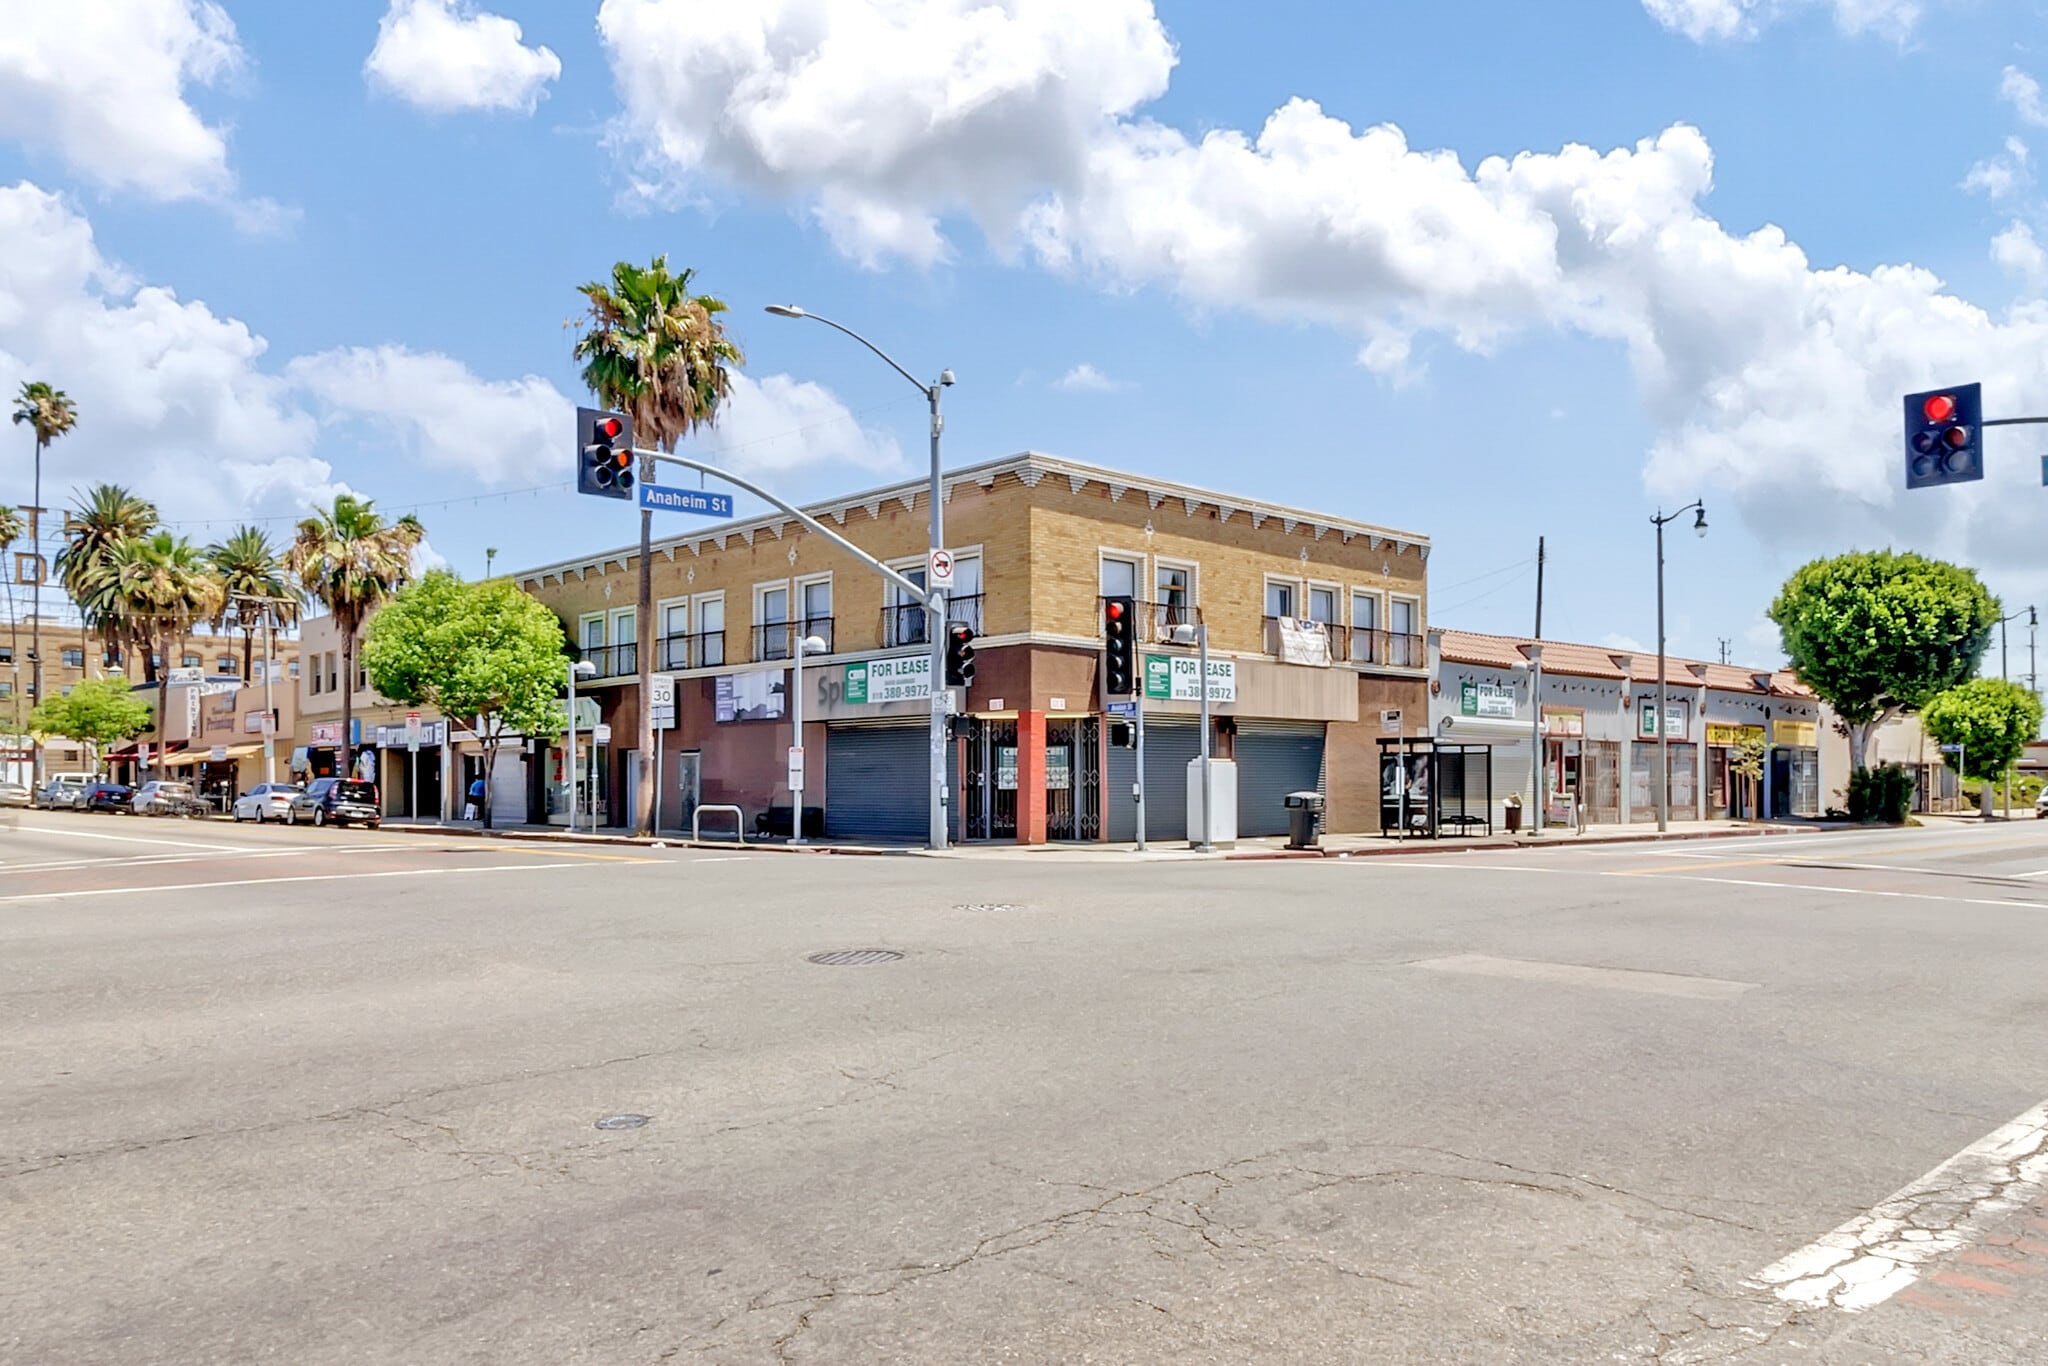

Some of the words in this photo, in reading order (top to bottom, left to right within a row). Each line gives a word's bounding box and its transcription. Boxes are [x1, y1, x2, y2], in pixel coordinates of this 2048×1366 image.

[646, 489, 707, 509] Anaheim
[711, 497, 727, 512] St
[871, 663, 892, 677] FOR
[896, 659, 929, 675] LEASE
[1175, 661, 1196, 674] FOR
[1206, 663, 1232, 677] EASE
[654, 690, 671, 702] 30
[884, 684, 929, 699] 380-9972
[1188, 686, 1232, 699] 38-9972
